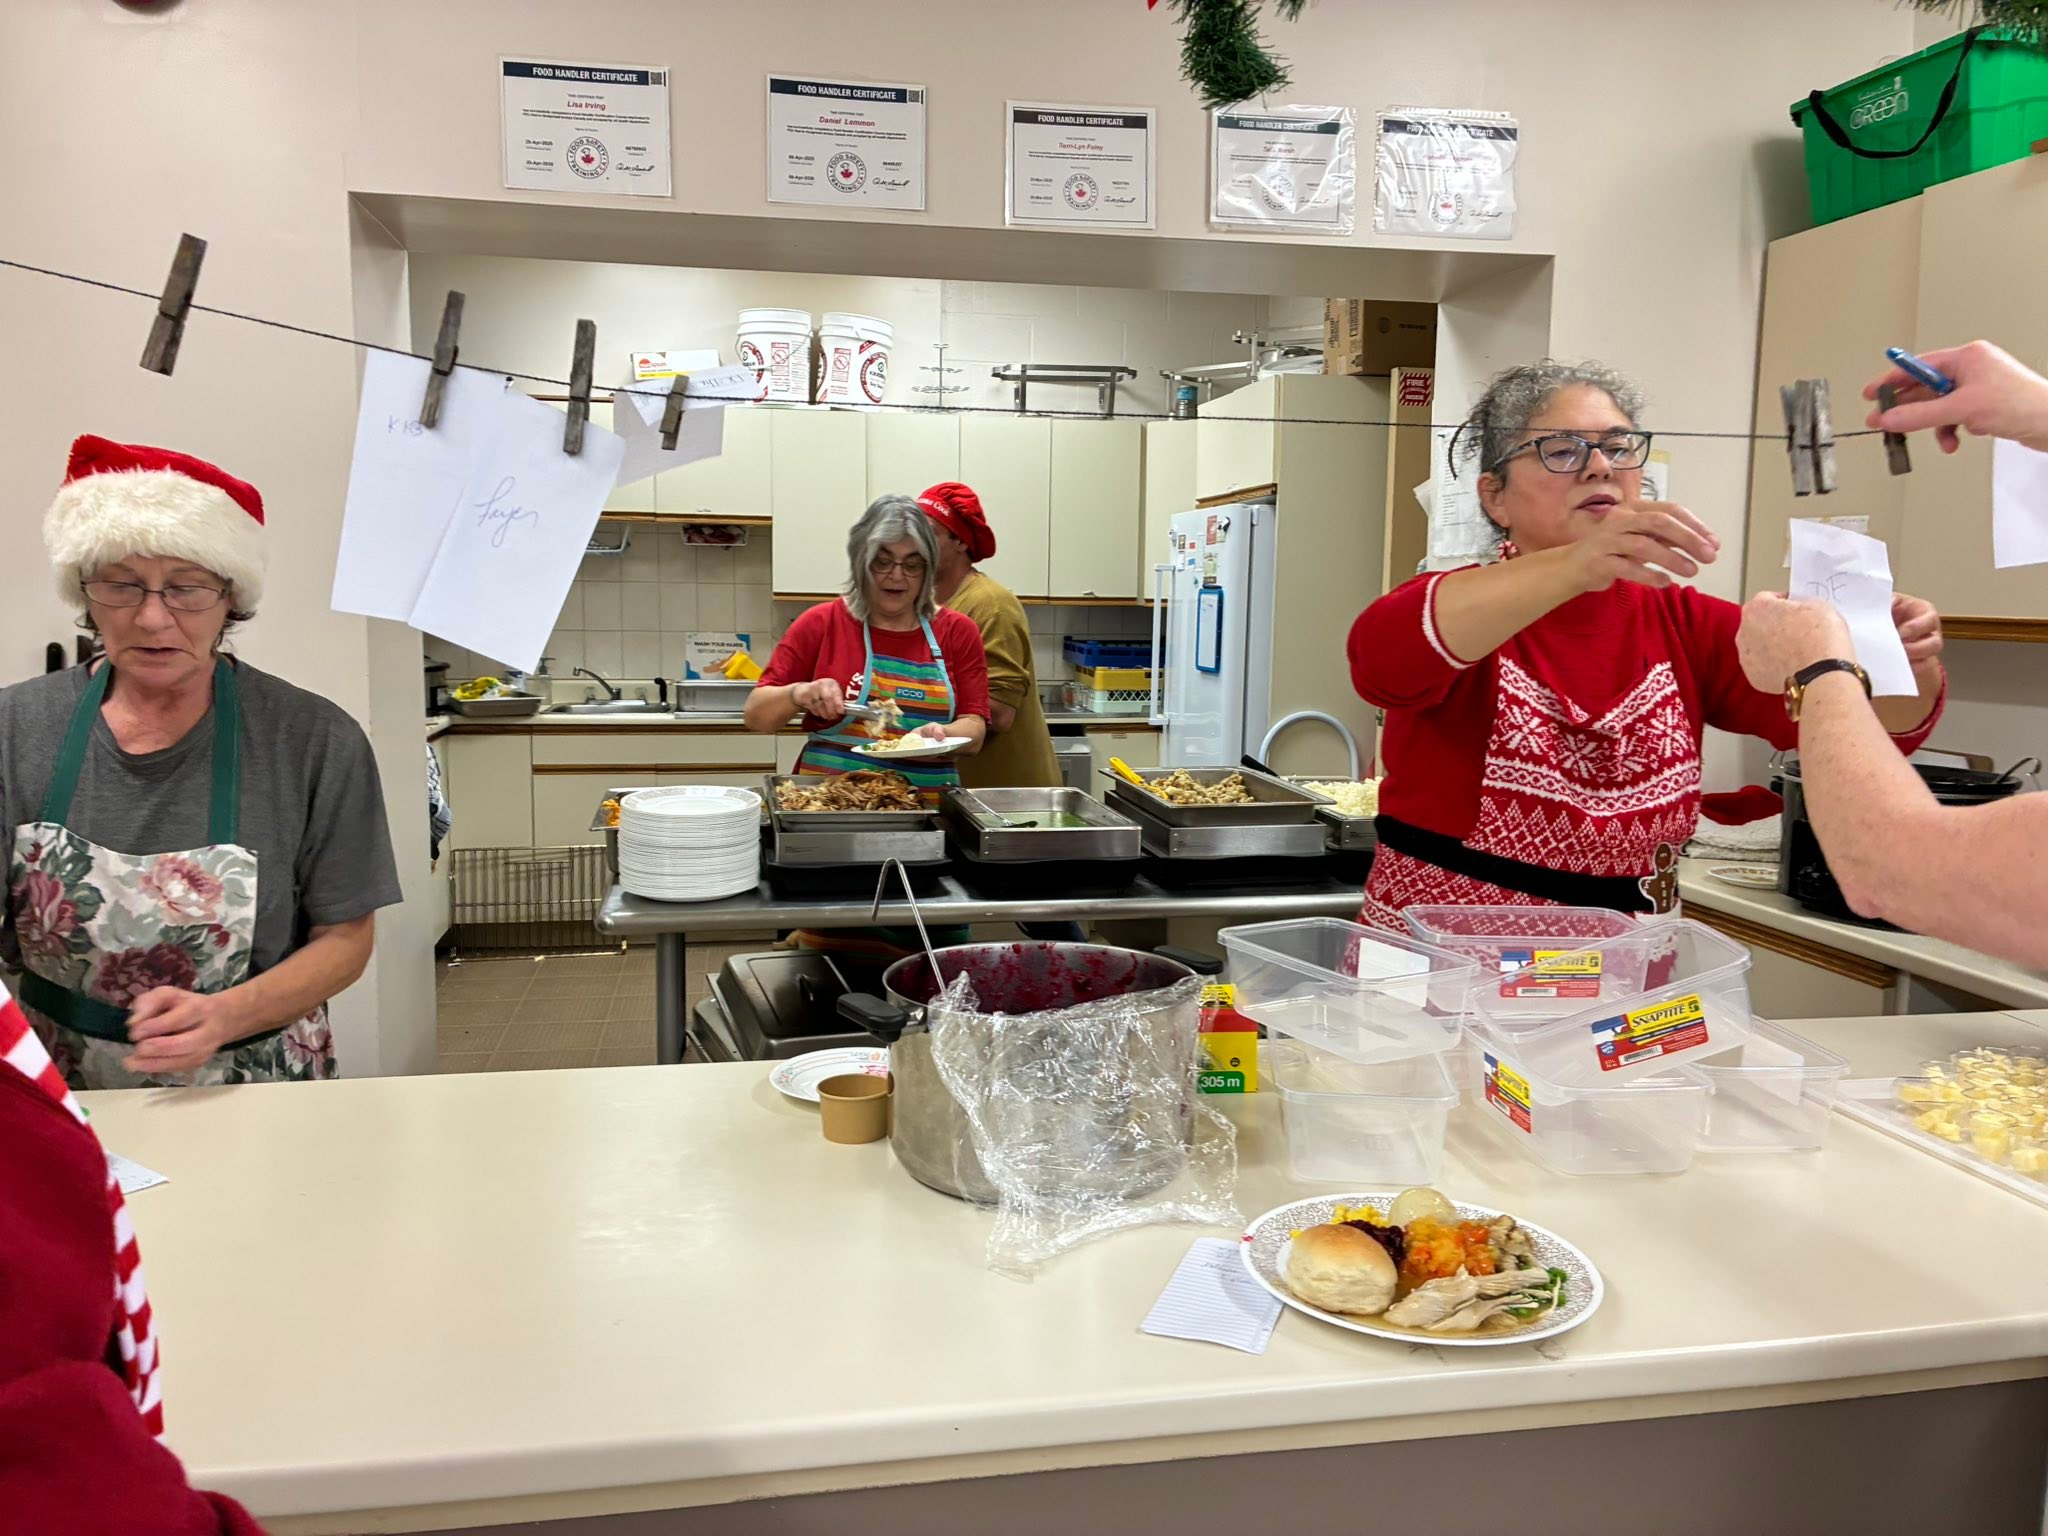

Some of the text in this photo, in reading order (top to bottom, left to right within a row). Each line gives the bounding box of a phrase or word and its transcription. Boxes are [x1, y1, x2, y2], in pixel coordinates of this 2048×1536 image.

[532, 66, 638, 83] FOOD HANDLER CERTIFICATE
[797, 84, 897, 100] FOOD HANDLER CERTIFICATE
[567, 101, 606, 111] Lisa Irving
[819, 116, 842, 125] Daniel
[1037, 114, 1124, 126] FOOD HANDLER CERTIFICATE
[1238, 120, 1255, 128] FOOD
[1255, 121, 1282, 130] HANDLER
[1406, 379, 1425, 387] FIRE
[1632, 1004, 1686, 1029] SNAPTITE
[1200, 1076, 1240, 1088] 305 m
